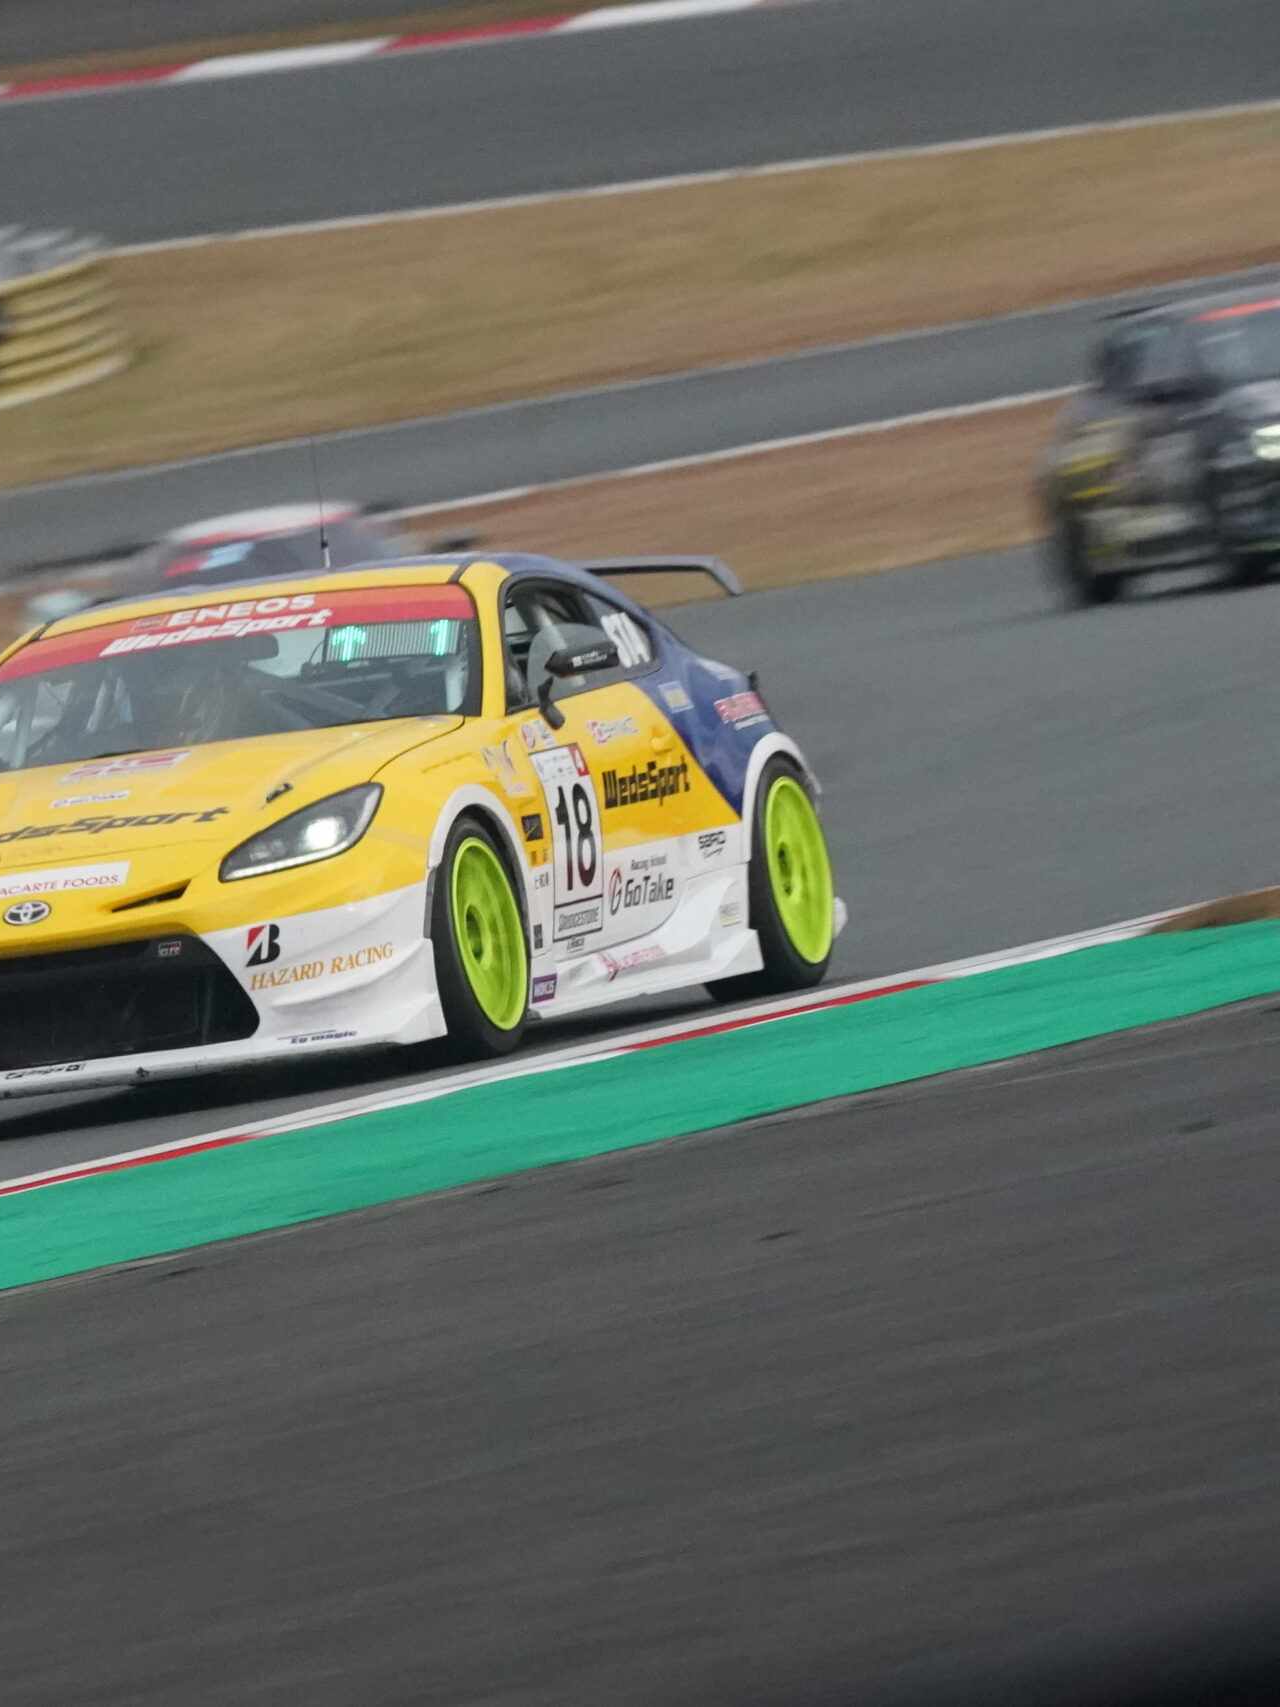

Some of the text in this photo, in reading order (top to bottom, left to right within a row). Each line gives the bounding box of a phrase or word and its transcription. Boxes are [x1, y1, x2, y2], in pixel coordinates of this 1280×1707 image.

[99, 608, 333, 657] WedsSport
[167, 594, 316, 627] ENEOS
[602, 753, 690, 809] WedsSport
[555, 783, 597, 891] 18
[63, 874, 119, 889] FOODS
[624, 872, 674, 908] GoTake
[250, 942, 394, 991] HAZARD RACING
